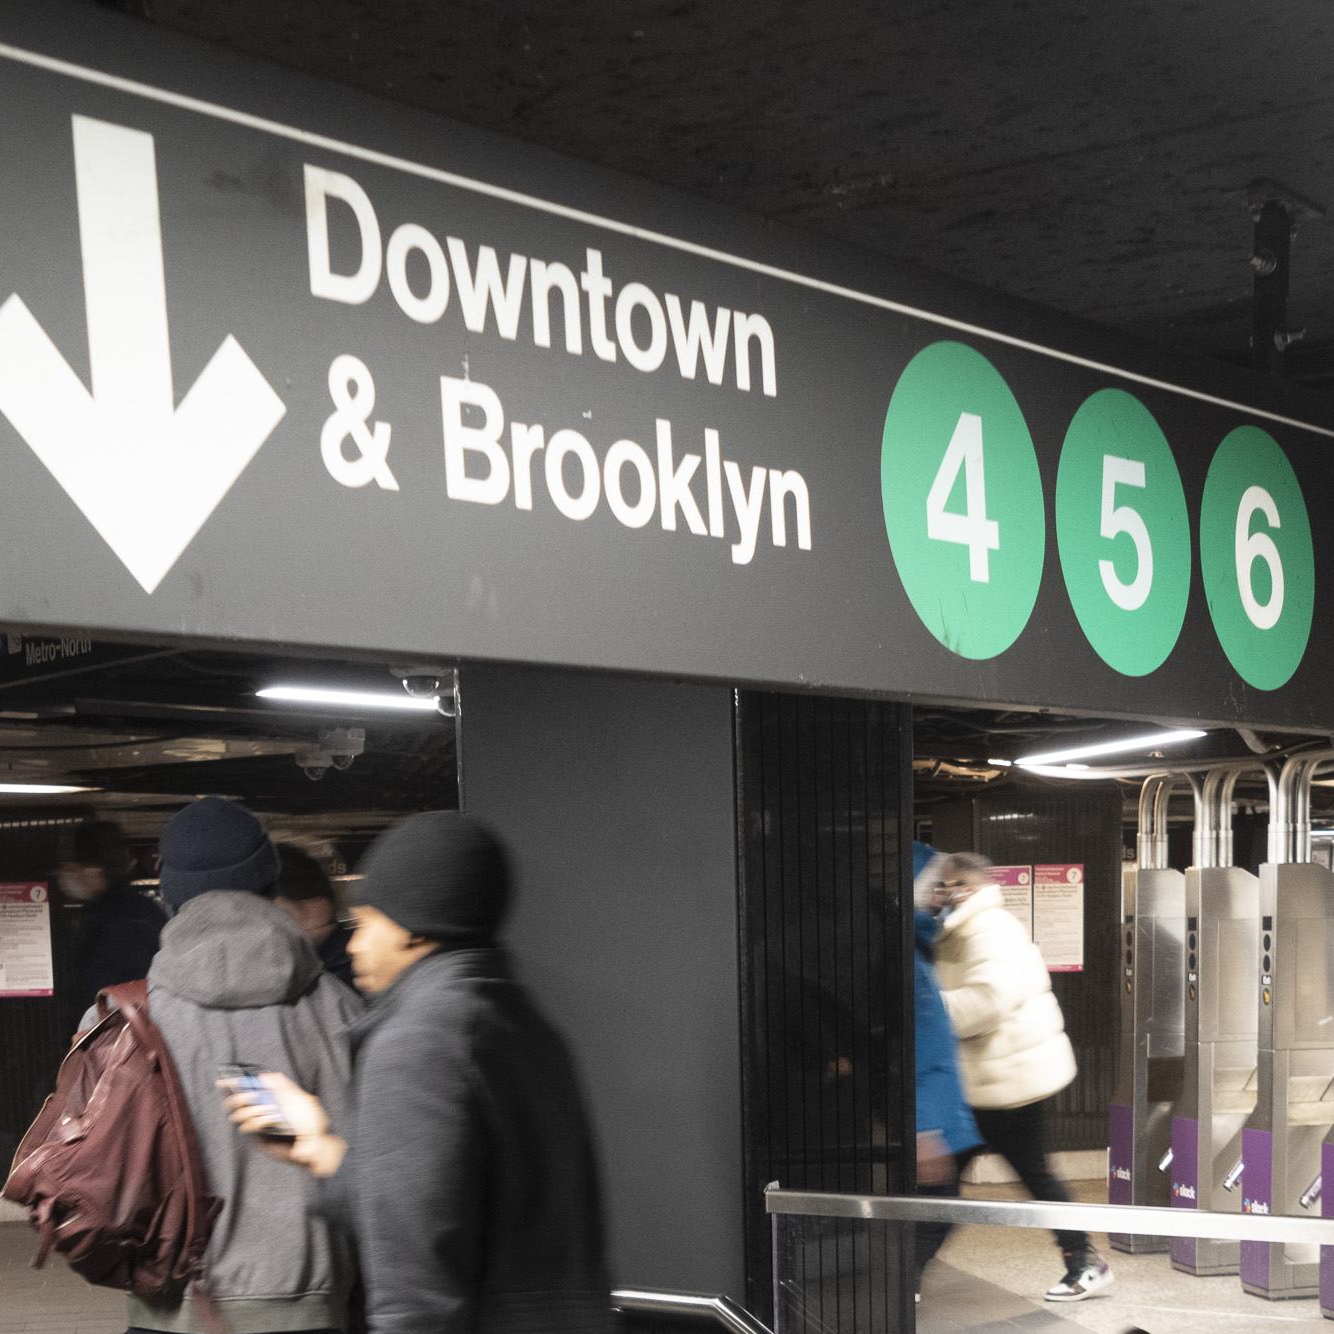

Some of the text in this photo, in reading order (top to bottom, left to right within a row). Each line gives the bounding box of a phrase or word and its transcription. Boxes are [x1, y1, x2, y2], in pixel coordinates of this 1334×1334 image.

[303, 163, 777, 398] Downtown
[320, 354, 812, 565] & Brooklyn
[926, 411, 1285, 630] 4 5 6
[25, 636, 92, 666] Metro-North
[1116, 1167, 1131, 1181] slack
[1179, 1184, 1195, 1200] slack
